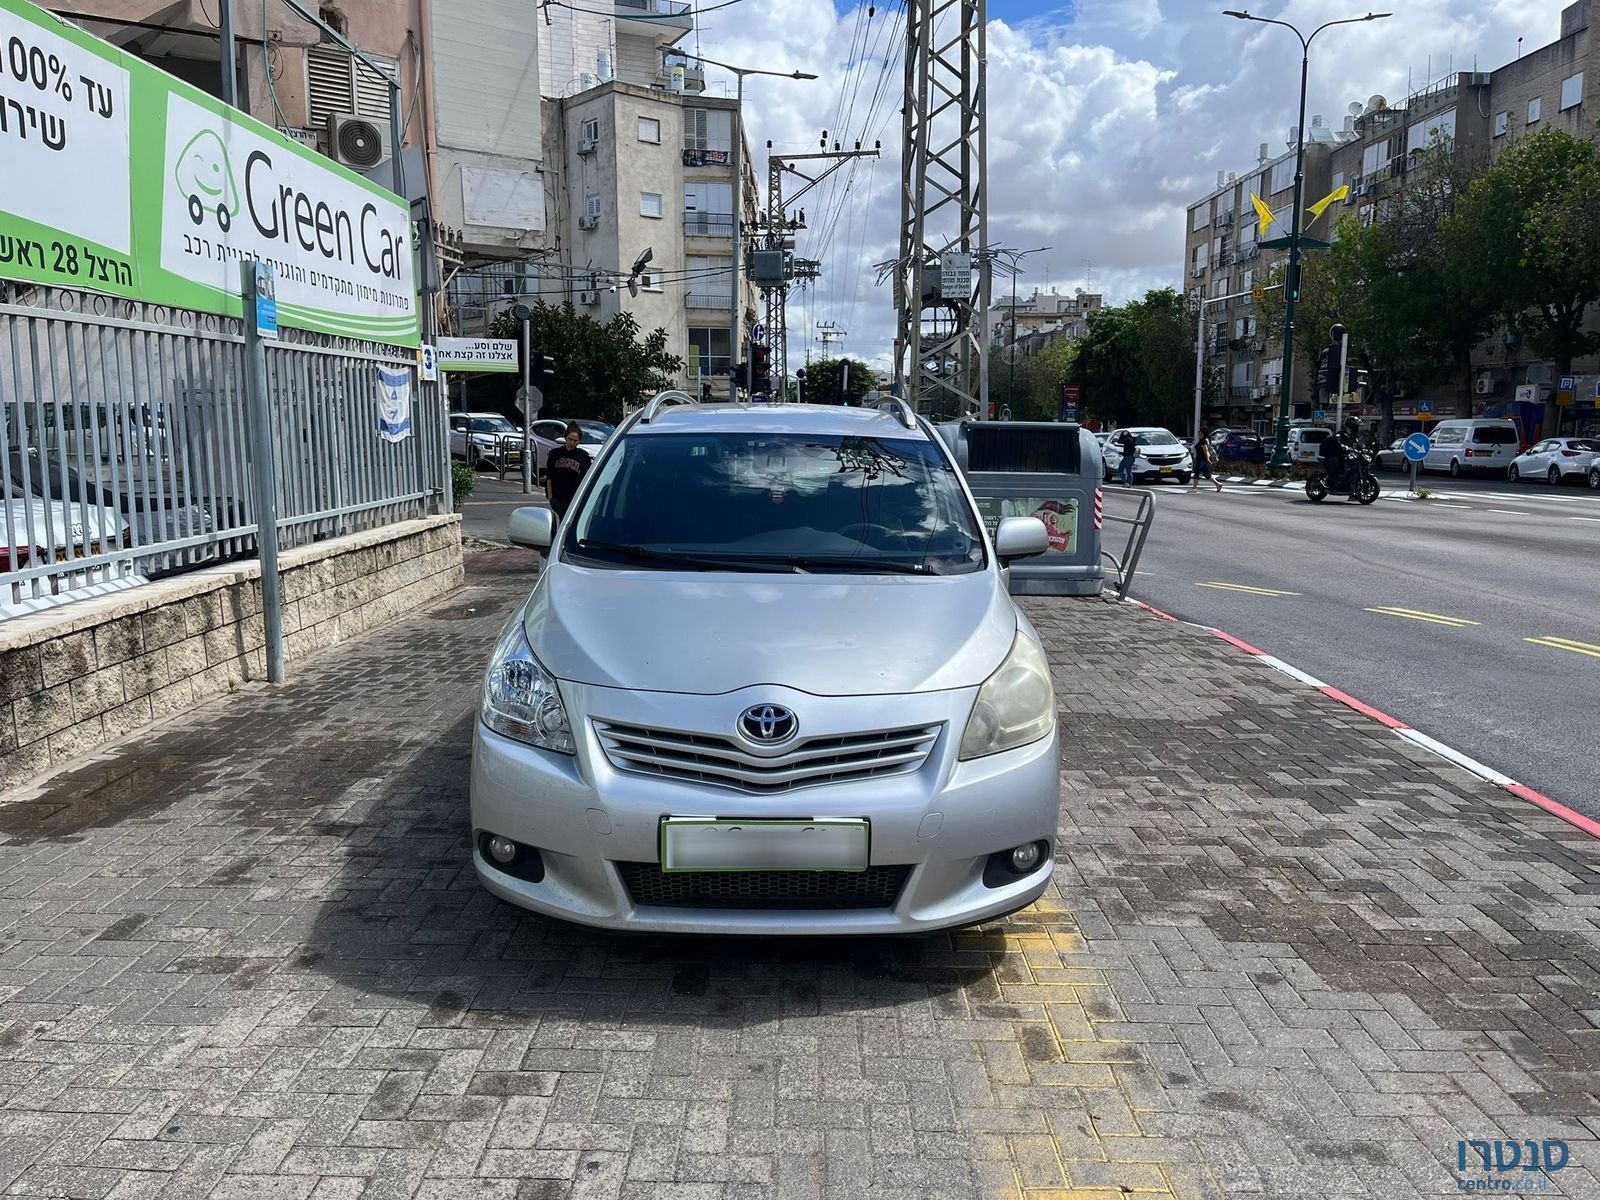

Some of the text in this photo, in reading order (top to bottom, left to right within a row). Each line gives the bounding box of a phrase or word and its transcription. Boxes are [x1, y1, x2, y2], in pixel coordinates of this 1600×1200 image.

[79, 75, 113, 119] עד
[245, 150, 404, 280] Green Car
[184, 234, 211, 258] רכב
[51, 241, 79, 275] 28
[83, 246, 133, 287] הרצל
[310, 270, 354, 296] מתקדמים
[356, 283, 378, 302] מימון
[1254, 288, 1263, 297] 13
[380, 290, 409, 310] פתרונות
[453, 351, 474, 360] קצת
[465, 341, 512, 351] שלם וסע...
[475, 351, 486, 359] זה
[488, 350, 513, 360] אצלנו
